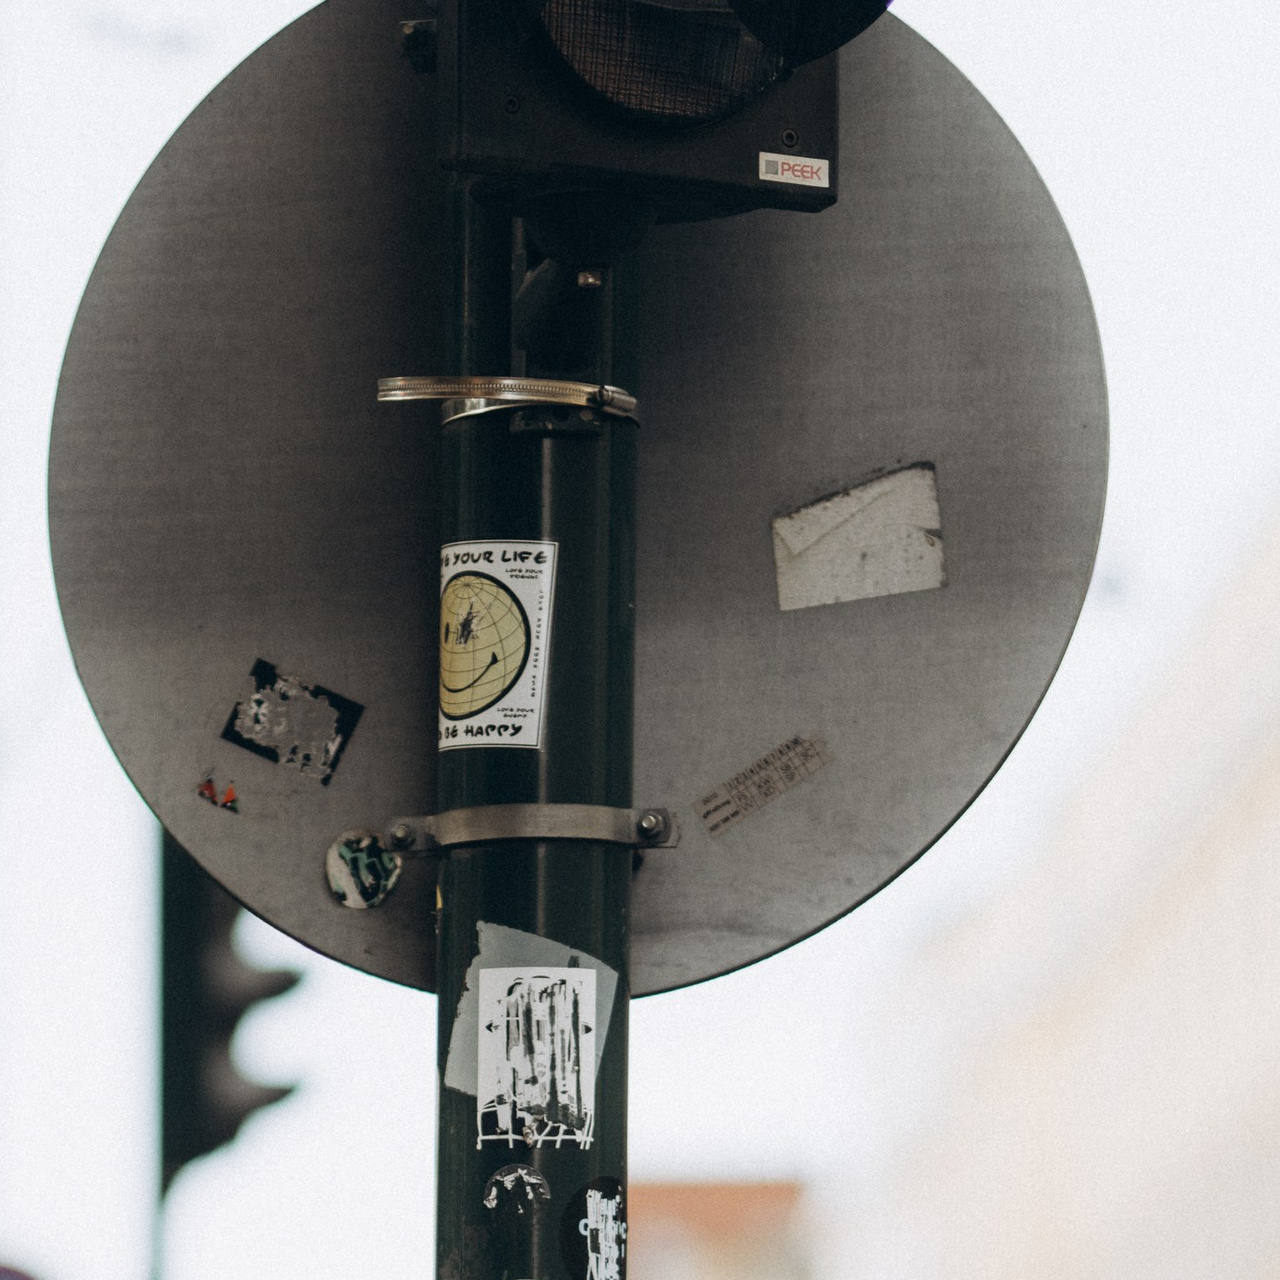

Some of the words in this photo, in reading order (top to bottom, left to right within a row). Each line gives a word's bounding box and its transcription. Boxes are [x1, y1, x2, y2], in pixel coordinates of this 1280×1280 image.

[781, 162, 821, 181] PEEK
[453, 551, 494, 566] YOUR
[501, 550, 547, 565] LIFE
[444, 725, 458, 739] BE
[464, 723, 523, 737] HAPPY
